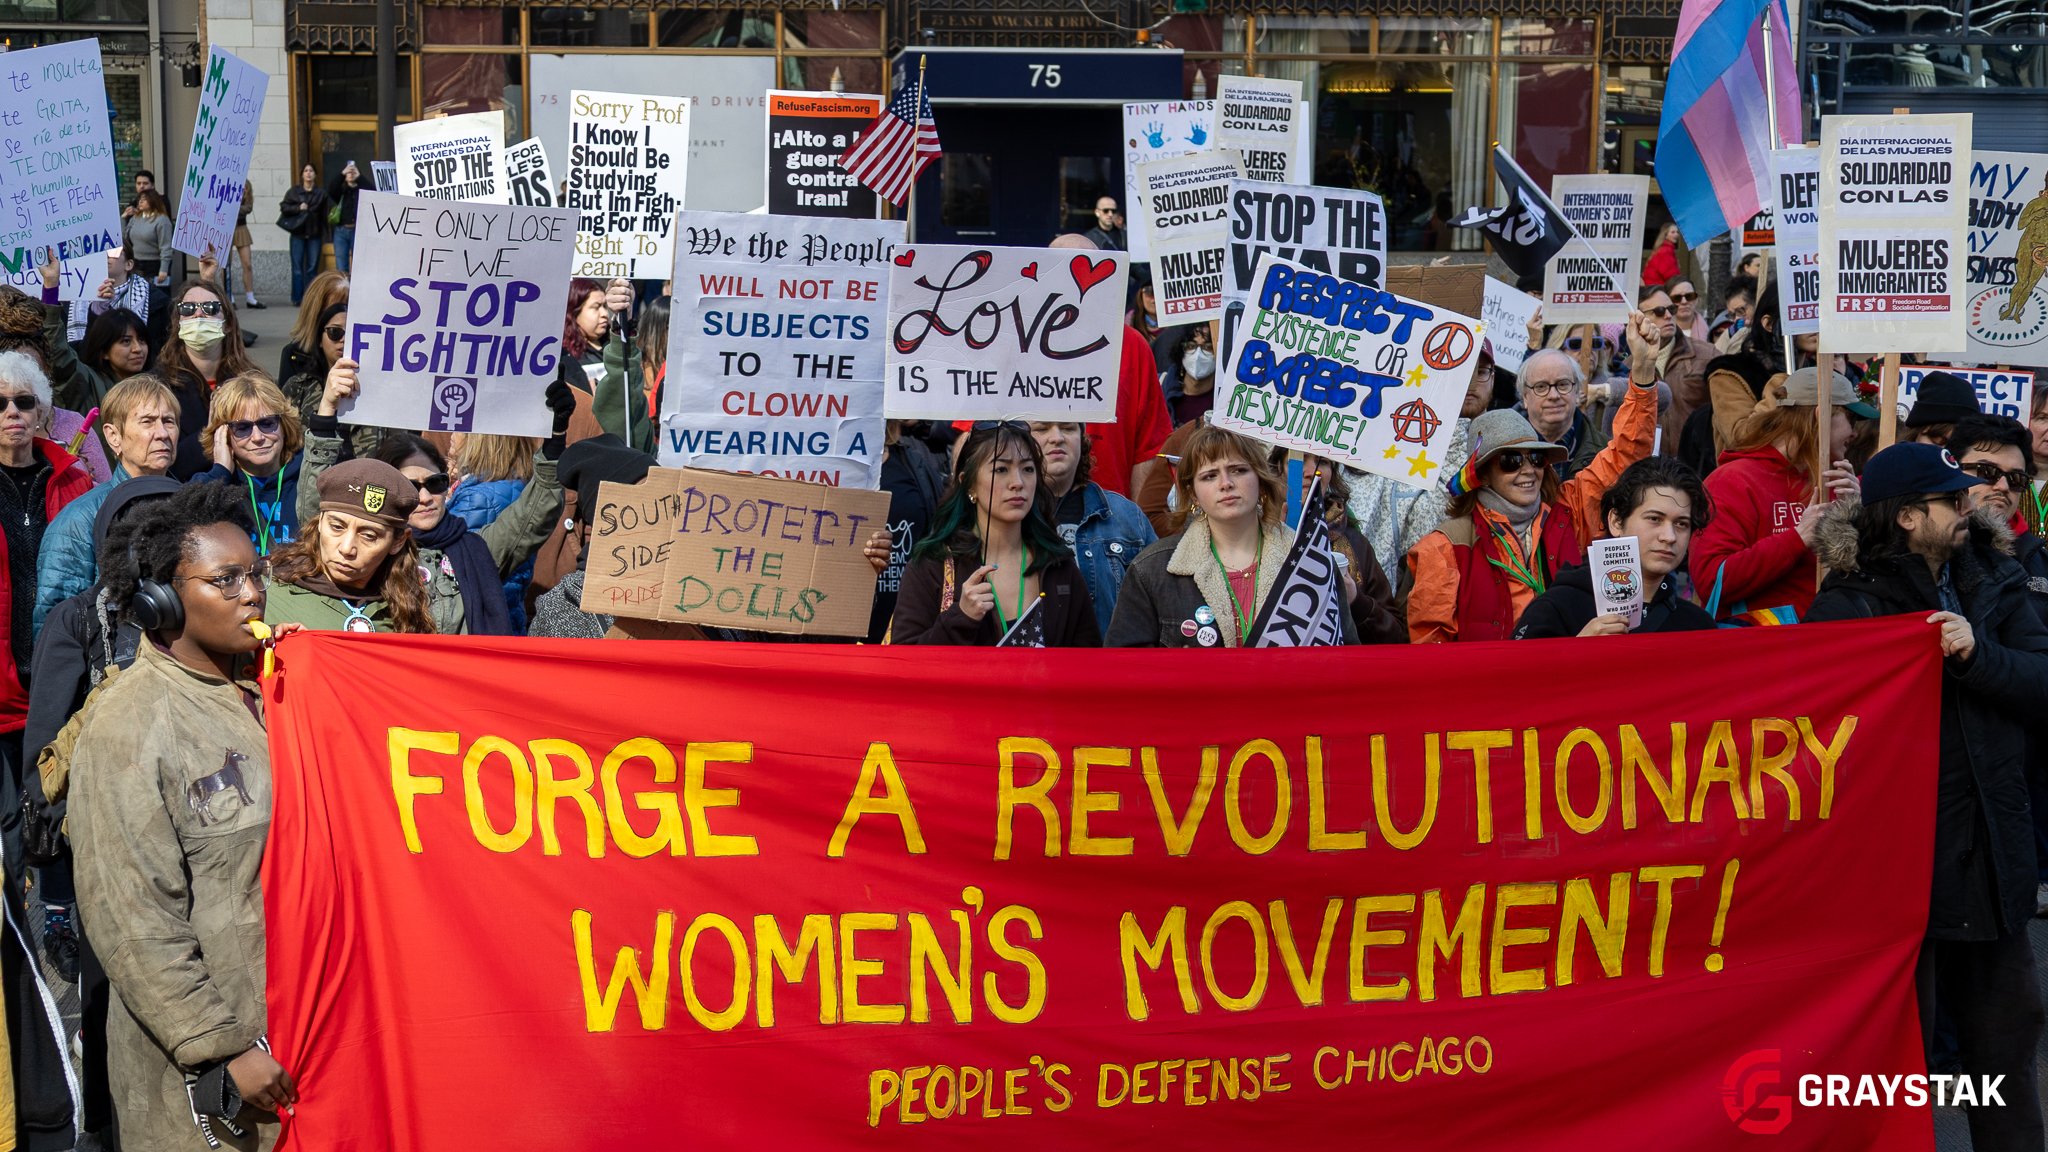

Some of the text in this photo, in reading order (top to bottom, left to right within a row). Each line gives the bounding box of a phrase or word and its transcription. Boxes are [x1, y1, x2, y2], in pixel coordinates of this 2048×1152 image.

[950, 15, 985, 27] EAST
[992, 15, 1053, 27] WACKER
[205, 53, 230, 108] My
[1028, 64, 1061, 88] 75
[1237, 89, 1292, 97] INTERNACIONAL
[1254, 95, 1293, 104] MUJERES
[574, 94, 685, 124] Sorry Prof
[777, 100, 870, 115] RefuseFascism.org
[1126, 100, 1214, 116] TINY HANDS
[1223, 103, 1291, 121] SOLIDARIDAD
[199, 103, 218, 140] My
[573, 122, 651, 146] I Know I
[1222, 120, 1288, 133] CON LAS
[193, 133, 212, 170] My
[410, 136, 491, 153] INTERNATIONAL
[465, 143, 491, 154] DAY
[774, 129, 846, 149] ¡Alto a
[1839, 137, 1952, 146] DÍA INTERNACIONAL
[1840, 146, 1953, 155] DE LAS MUJERES
[512, 143, 540, 162] FOR
[570, 145, 670, 169] Should Be
[10, 156, 37, 176] TE
[413, 152, 494, 189] STOP THE
[1148, 164, 1236, 182] DÍA INTERNACIONAL
[1839, 161, 1952, 186] SOLIDARIDAD
[187, 164, 205, 198] My
[569, 168, 658, 196] Studying
[787, 171, 858, 187] contra
[1150, 170, 1239, 190] DE LAS MUJERES
[1969, 161, 2030, 200] MY
[38, 197, 59, 216] TE
[67, 183, 103, 209] PEGA
[569, 189, 631, 212] But Im
[797, 189, 848, 207] Iran!
[1563, 193, 1633, 206] INTERNATIONAL
[1839, 189, 1949, 203] CON LAS
[45, 212, 94, 232] SUFRIENDO
[371, 203, 566, 242] WE ONLY LOSE
[608, 211, 672, 238] For my
[1155, 212, 1199, 228] CON
[1231, 190, 1381, 250] STOP THE
[1562, 207, 1633, 221] WOMEN'S DAY
[1601, 223, 1631, 238] WITH
[574, 234, 658, 259] Right To
[686, 226, 737, 256] We
[748, 232, 788, 263] the
[1838, 239, 1949, 271] MUJERES
[418, 248, 519, 277] IF WE
[1160, 247, 1225, 281] MUJER
[1557, 257, 1628, 274] IMMIGRANT
[700, 274, 878, 301] WILL NOT BE
[1567, 276, 1614, 291] WOMEN
[1838, 272, 1947, 294] INMIGRANTES
[381, 277, 541, 327] STOP
[893, 250, 1110, 360] Love
[1167, 298, 1206, 314] FRSO
[1258, 263, 1434, 345] RESPECT
[1555, 293, 1585, 303] FRSO
[1840, 297, 1887, 312] FRSO
[703, 311, 869, 340] SUBJECTS
[352, 323, 558, 377] FIGHTING
[1376, 344, 1408, 378] OR
[719, 351, 855, 380] TO THE
[899, 366, 1103, 401] IS THE ANSWER
[1236, 339, 1404, 419] EXPECT
[722, 390, 849, 417] CLOWN
[670, 428, 868, 456] WEARING A
[677, 486, 869, 547] PROTECT
[609, 540, 676, 577] SIDE
[1604, 544, 1631, 552] PEOPLE'S
[1605, 551, 1630, 559] DEFENSE
[712, 546, 784, 580] THE
[1602, 558, 1635, 566] COMMITTEE
[603, 581, 664, 606] PRIDE
[1267, 519, 1334, 646] FUCK
[673, 575, 829, 623] DOLLS
[388, 714, 1859, 861] FORGE A REVOLUTIONARY
[571, 857, 1740, 1033] WOMEN'S MOVEMENT!
[867, 1034, 1494, 1128] PEOPLE'S DEFENSE CHICAGO
